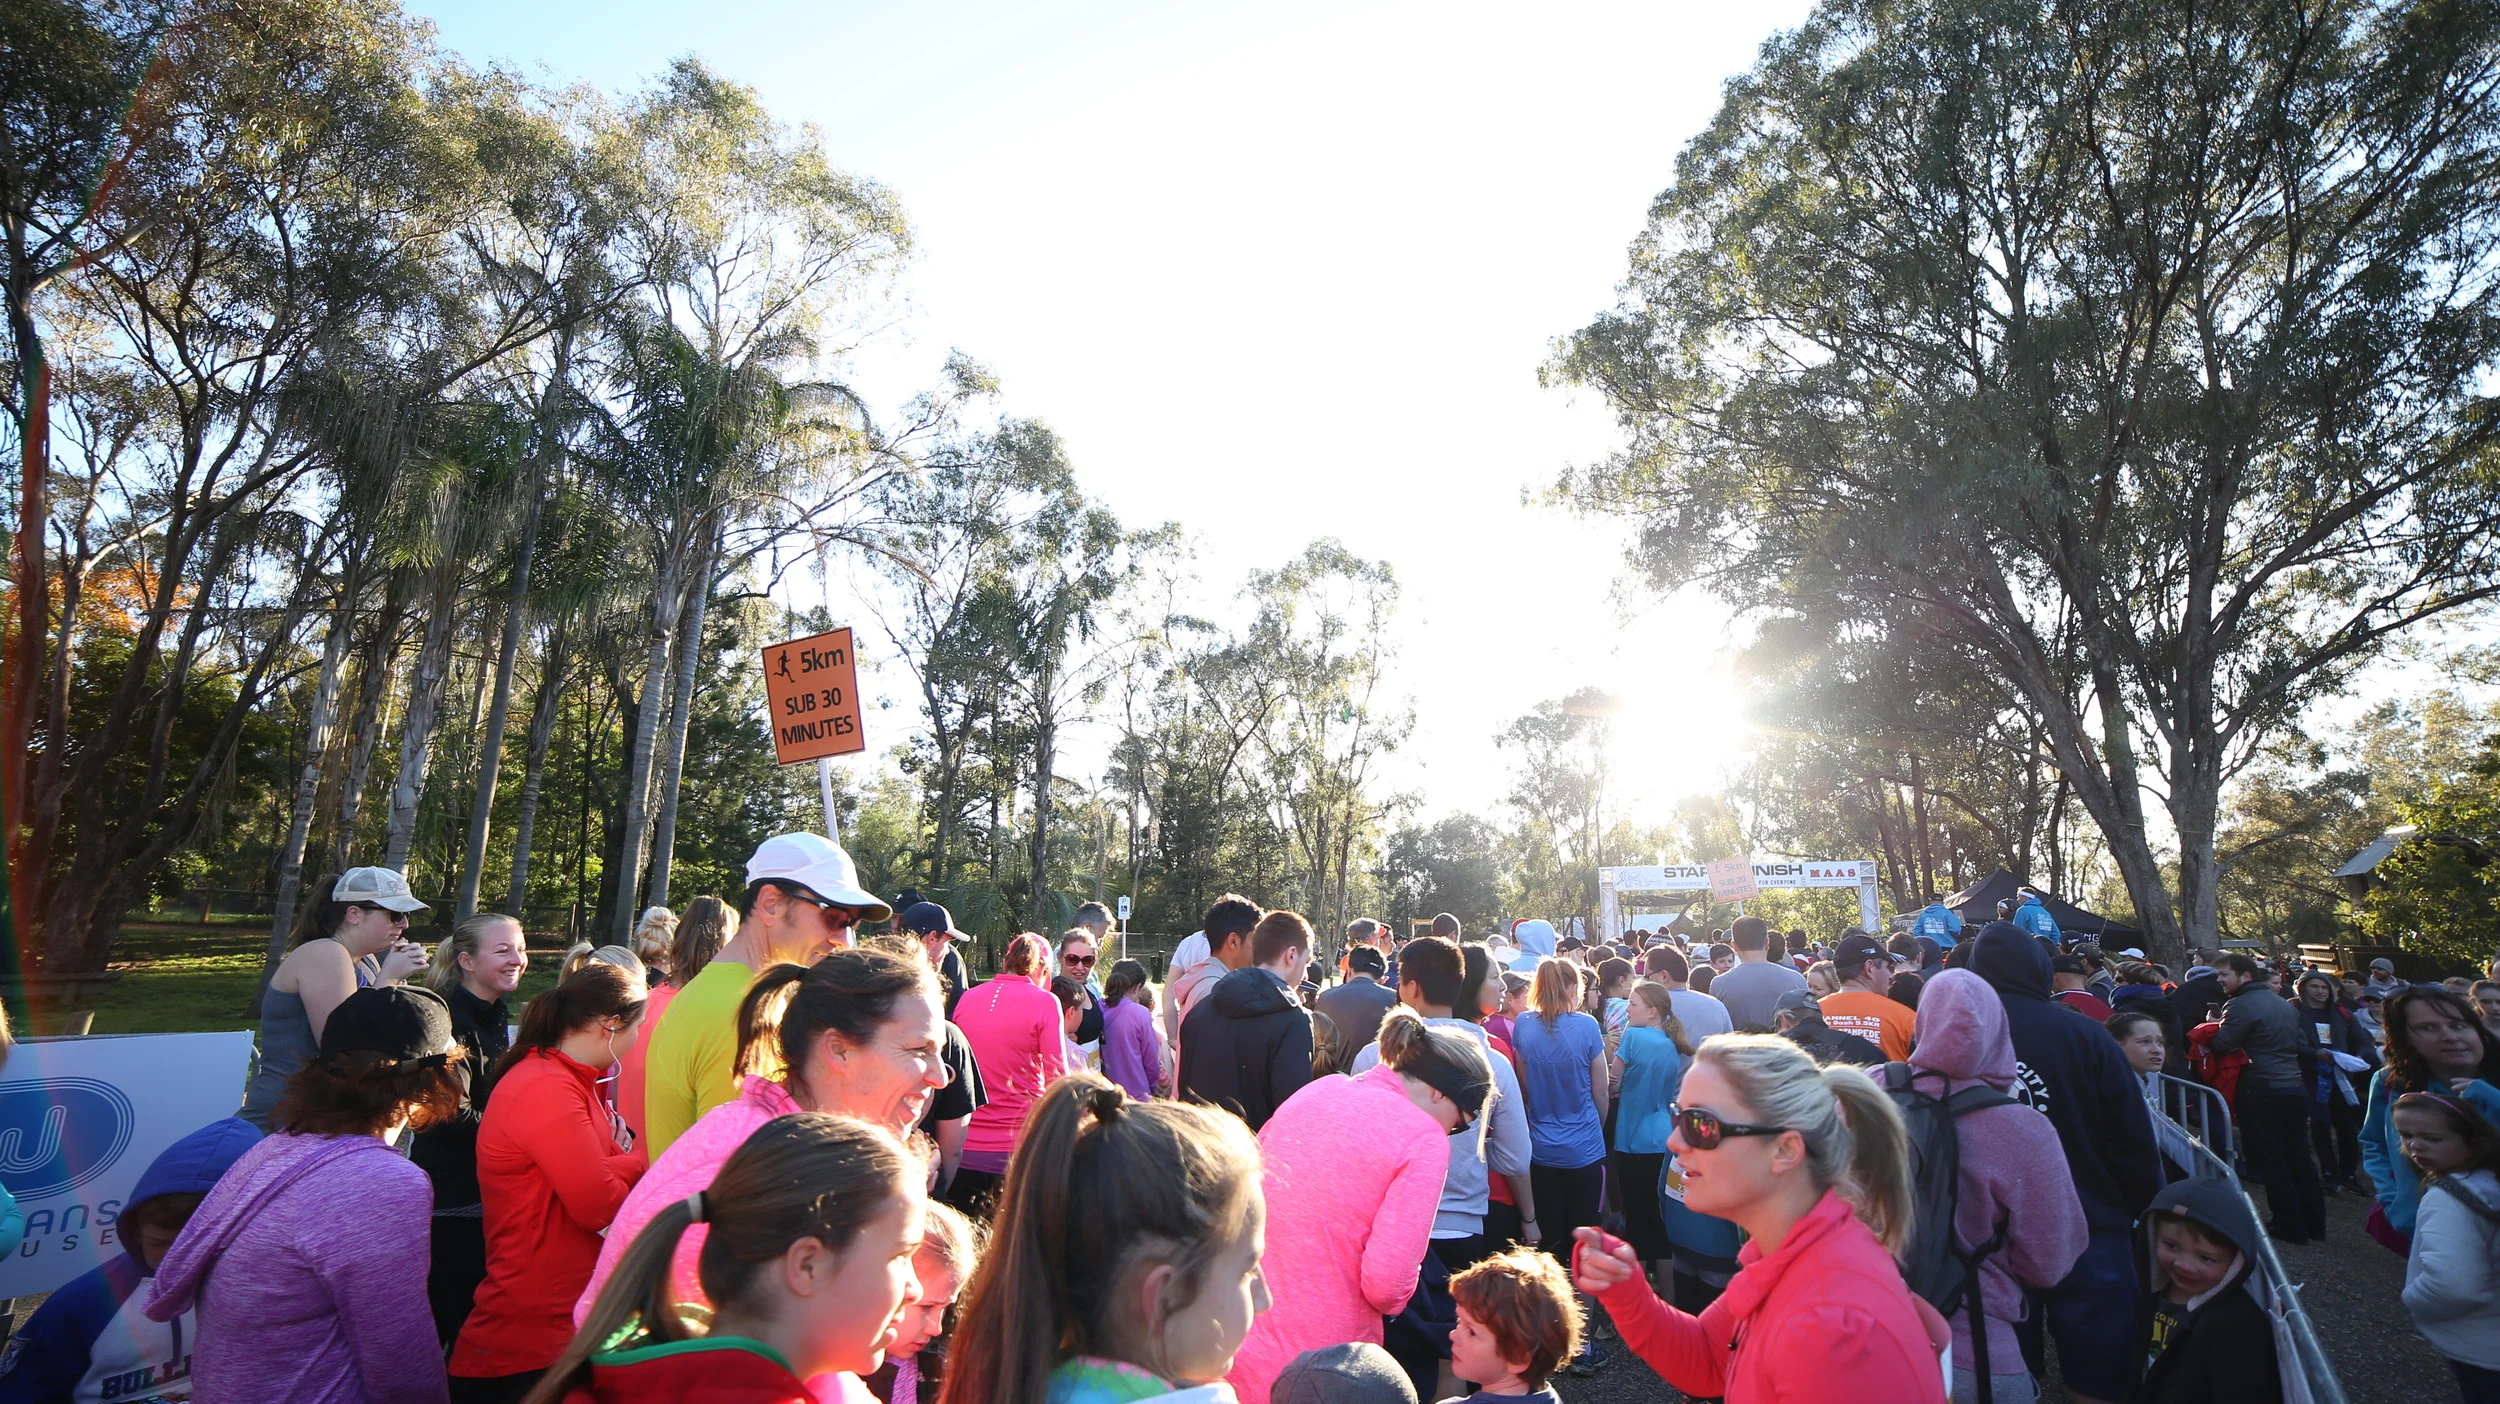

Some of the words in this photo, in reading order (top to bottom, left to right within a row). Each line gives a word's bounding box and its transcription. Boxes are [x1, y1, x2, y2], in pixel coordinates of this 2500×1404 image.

[801, 648, 844, 674] 5km
[785, 693, 816, 716] SUB
[821, 687, 842, 709] 30
[781, 715, 854, 746] MINUTES
[1664, 866, 1708, 878] STAR
[1751, 864, 1803, 876] INISH
[1725, 862, 1746, 872] 5km
[1809, 868, 1856, 878] MAAS
[1717, 886, 1753, 897] MINUTES
[1719, 878, 1734, 887] SUB
[1736, 876, 1747, 884] 20
[2015, 1061, 2050, 1099] CITY
[22, 1199, 121, 1239] ANS
[20, 1228, 115, 1258] USE
